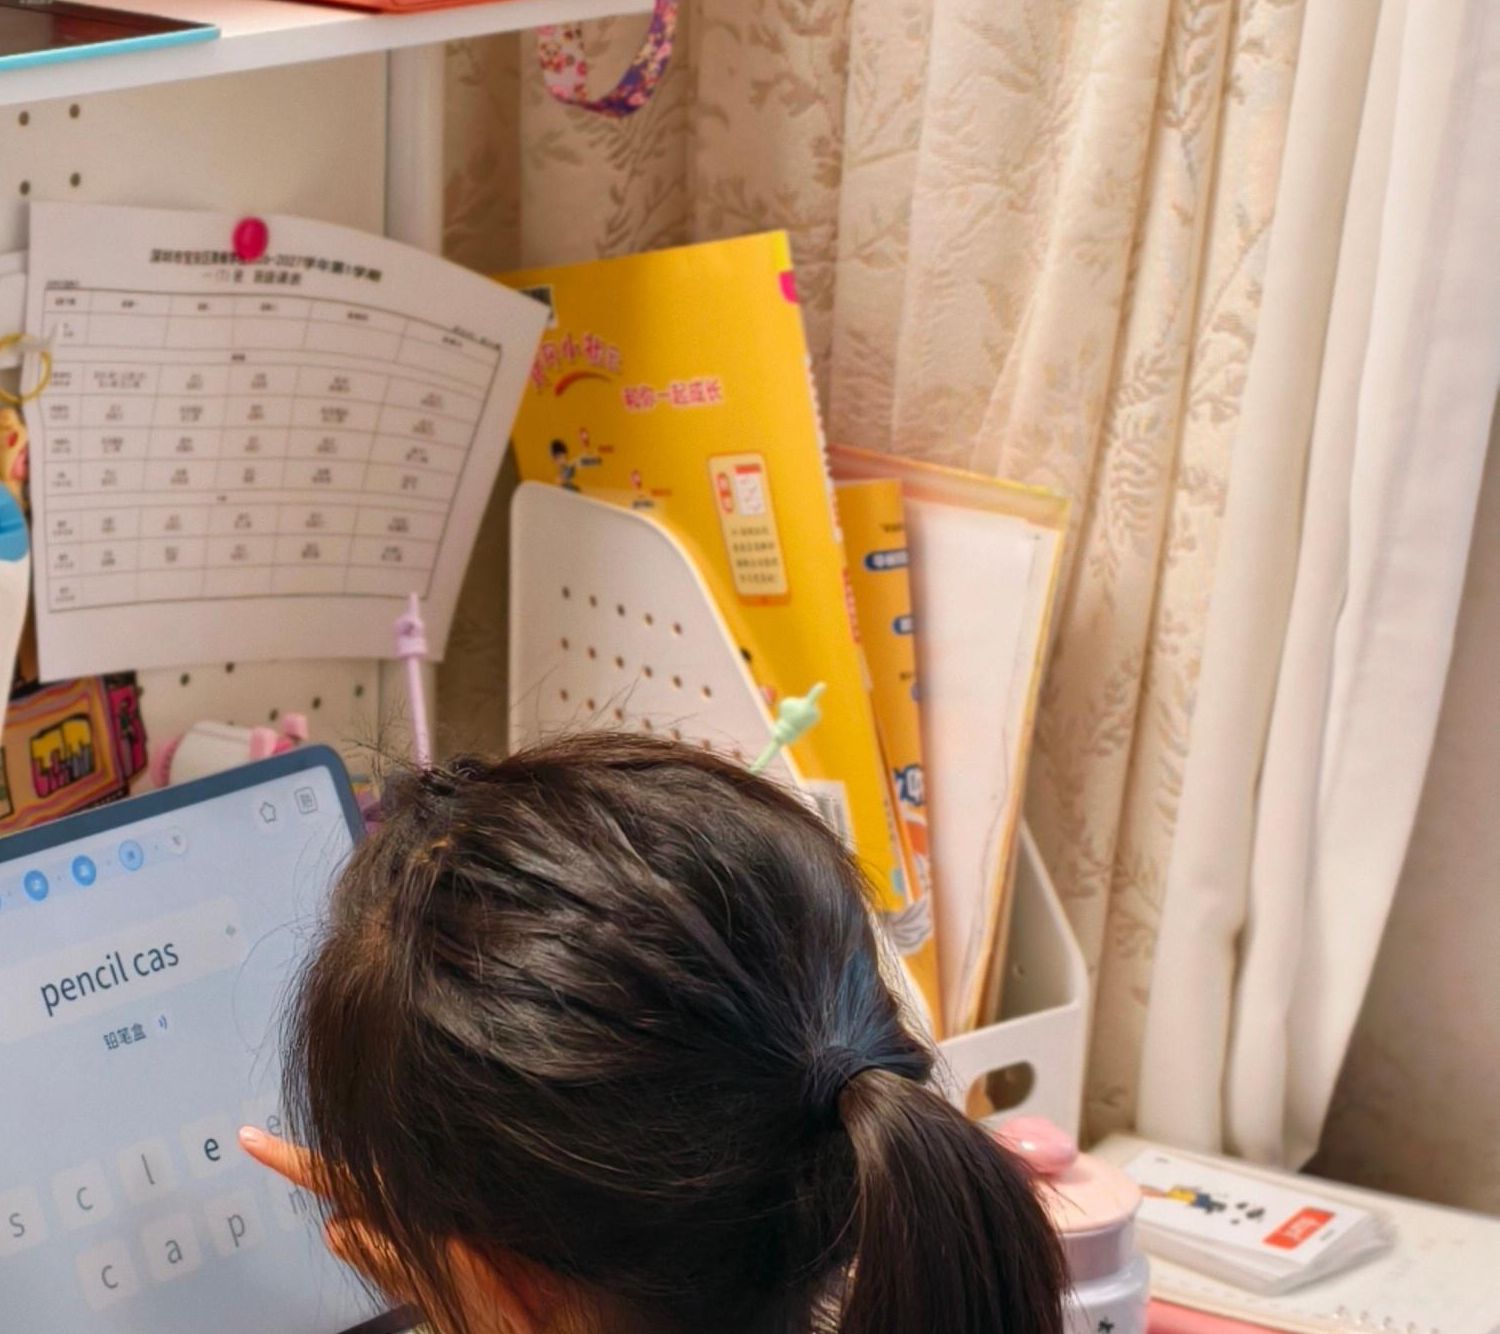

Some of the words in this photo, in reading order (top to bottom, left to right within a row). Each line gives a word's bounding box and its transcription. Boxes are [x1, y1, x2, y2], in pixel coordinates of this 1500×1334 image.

[40, 951, 130, 1017] pencil
[133, 940, 180, 977] cas
[103, 1022, 147, 1051] 铅笔盒
[9, 1213, 26, 1237] s
[76, 1186, 94, 1211] c
[141, 1153, 155, 1185] l
[204, 1137, 221, 1162] e
[266, 1114, 283, 1137] e
[100, 1264, 118, 1290] c
[164, 1239, 183, 1265] a
[228, 1213, 246, 1247] p
